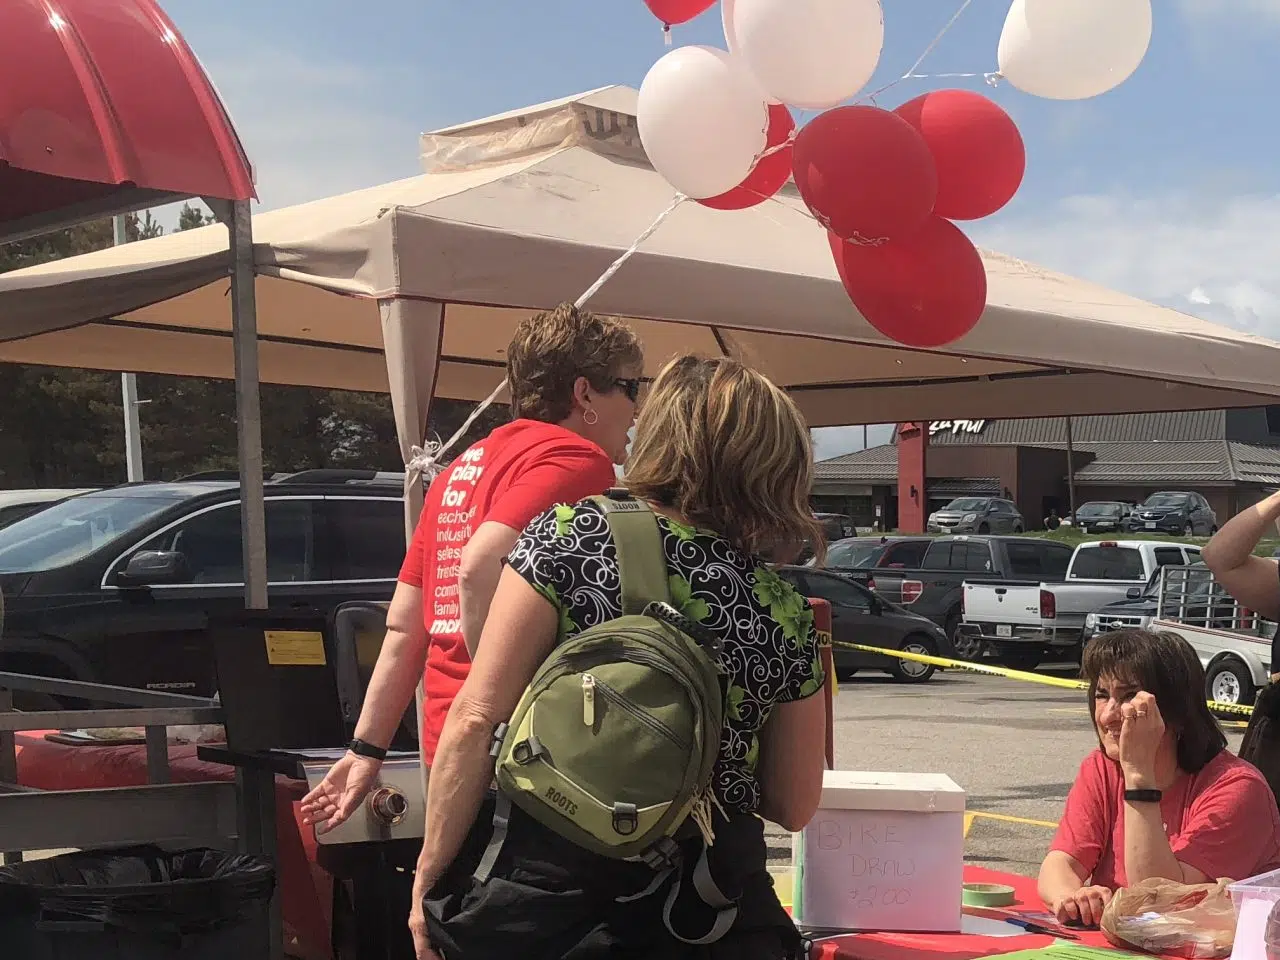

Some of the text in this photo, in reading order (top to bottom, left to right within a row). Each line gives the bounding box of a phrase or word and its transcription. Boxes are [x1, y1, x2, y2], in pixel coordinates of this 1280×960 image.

[461, 447, 484, 462] we
[448, 463, 484, 486] play
[441, 486, 467, 507] for
[545, 787, 578, 815] ROOTS
[817, 820, 904, 851] BIKE
